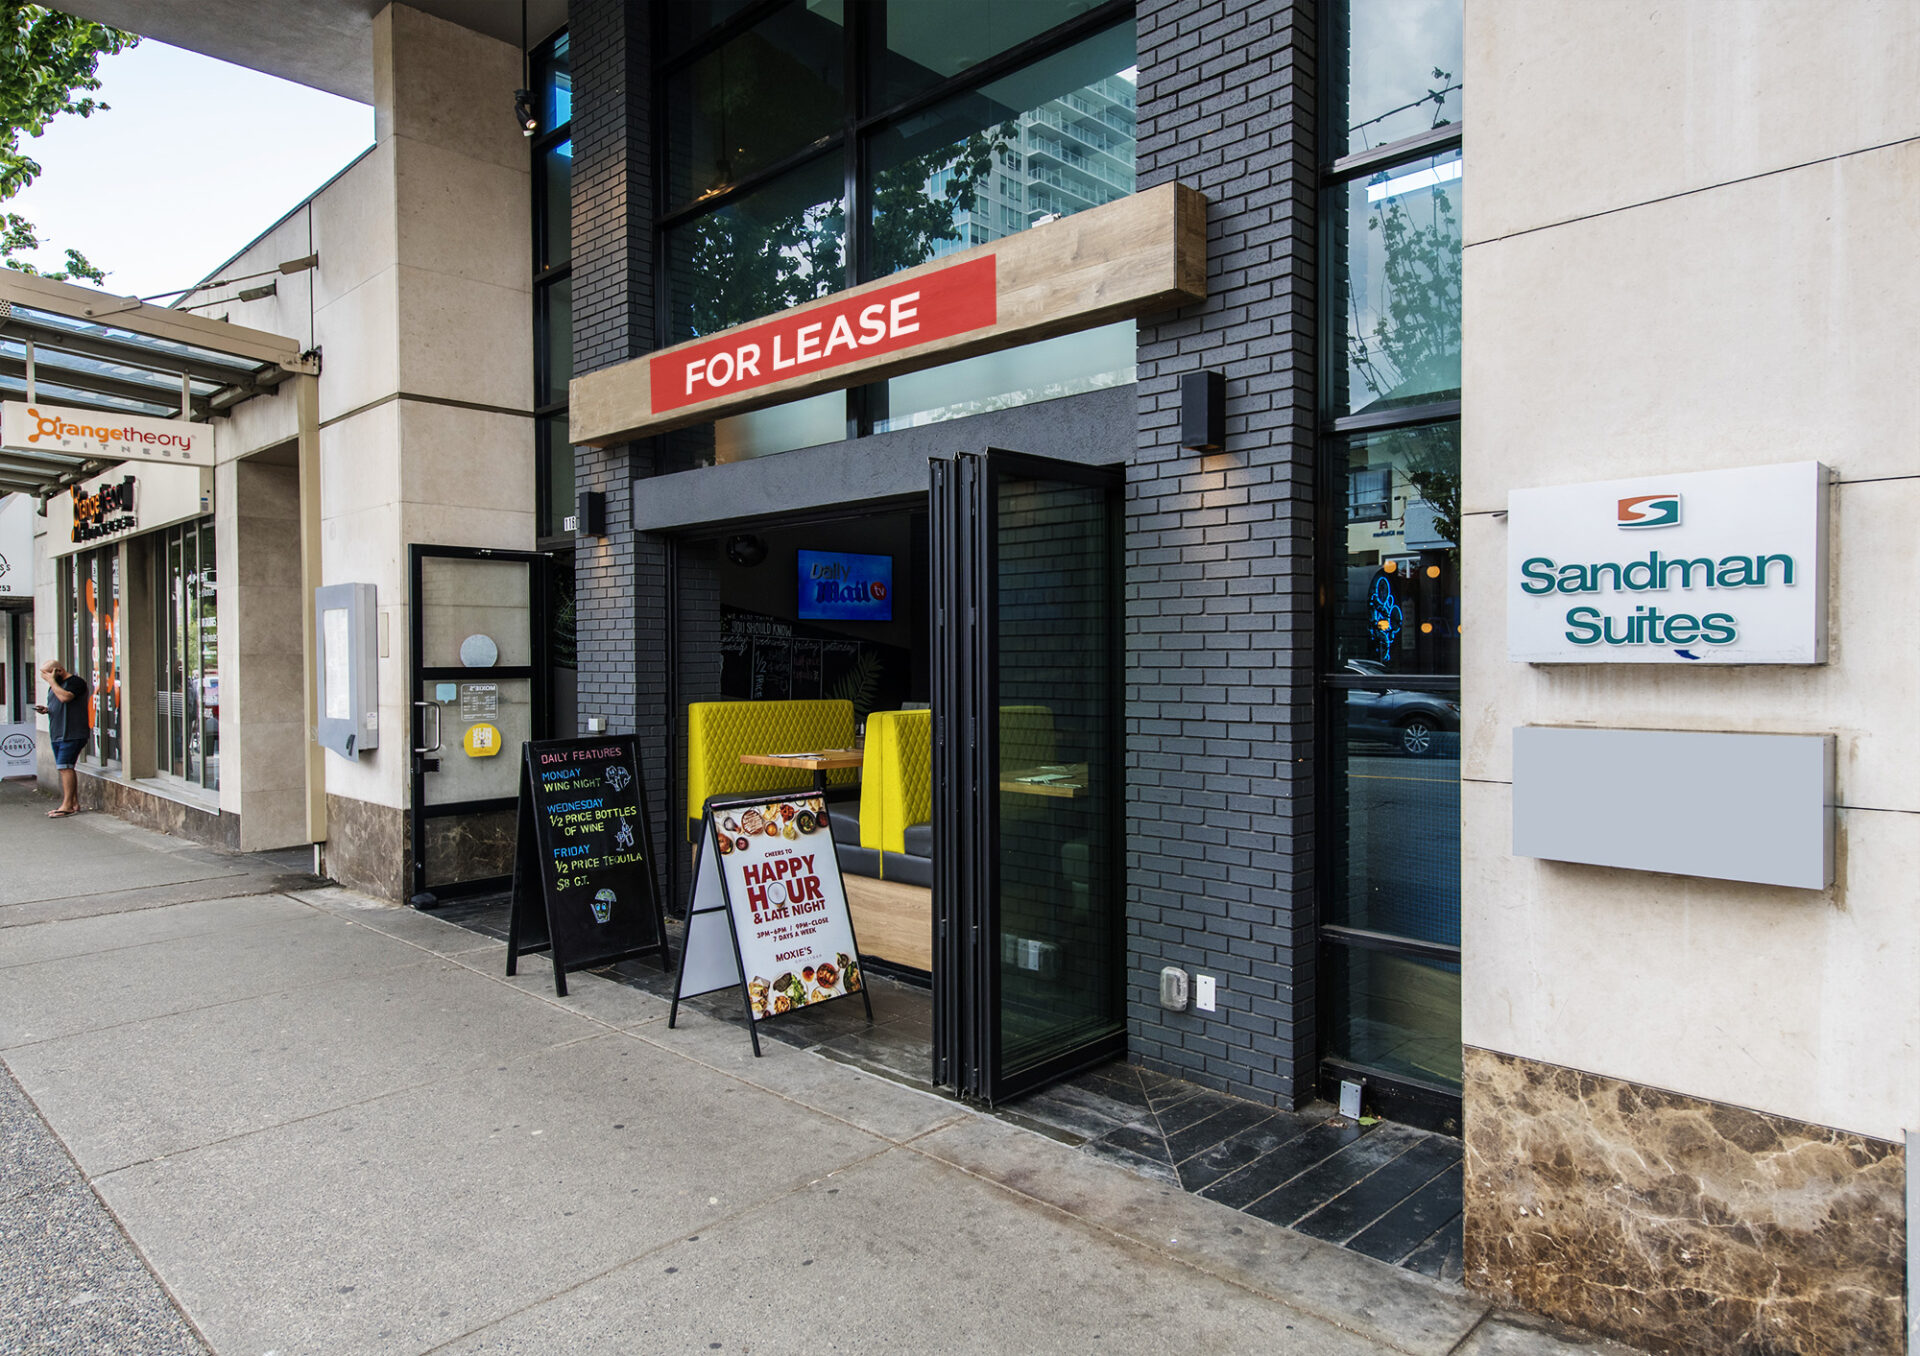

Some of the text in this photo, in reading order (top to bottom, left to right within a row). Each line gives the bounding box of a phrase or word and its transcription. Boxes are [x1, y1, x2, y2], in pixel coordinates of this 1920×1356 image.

[686, 291, 920, 395] FOR LEASE
[62, 439, 191, 459] FITNESS
[810, 560, 851, 583] Daily
[1520, 550, 1794, 595] Sandman
[816, 580, 871, 603] Mail
[731, 621, 793, 636] YOU SHOULD KNOW
[1565, 605, 1737, 645] Suites
[541, 747, 622, 764] DAILY FEATURES
[542, 768, 581, 781] MONDAY
[544, 778, 601, 792] WING NIGHT
[547, 798, 604, 814] WEDNESDAY
[565, 811, 592, 824] PRICE
[595, 806, 637, 820] BOTTLES
[564, 822, 605, 836] OF WINE
[554, 844, 591, 858] FRIDAY
[764, 849, 784, 858] CHEERS
[571, 858, 600, 870] PRICE
[603, 853, 643, 866] TEQUILA
[743, 854, 815, 886] HAPPY
[753, 900, 826, 924] & LATE NIGHT
[757, 927, 787, 939] 3PM-6PM
[795, 917, 829, 930] 9PM-CLOSE
[778, 933, 794, 941] DAYS
[800, 927, 817, 936] WEEK
[775, 946, 813, 962] MOXIE'S
